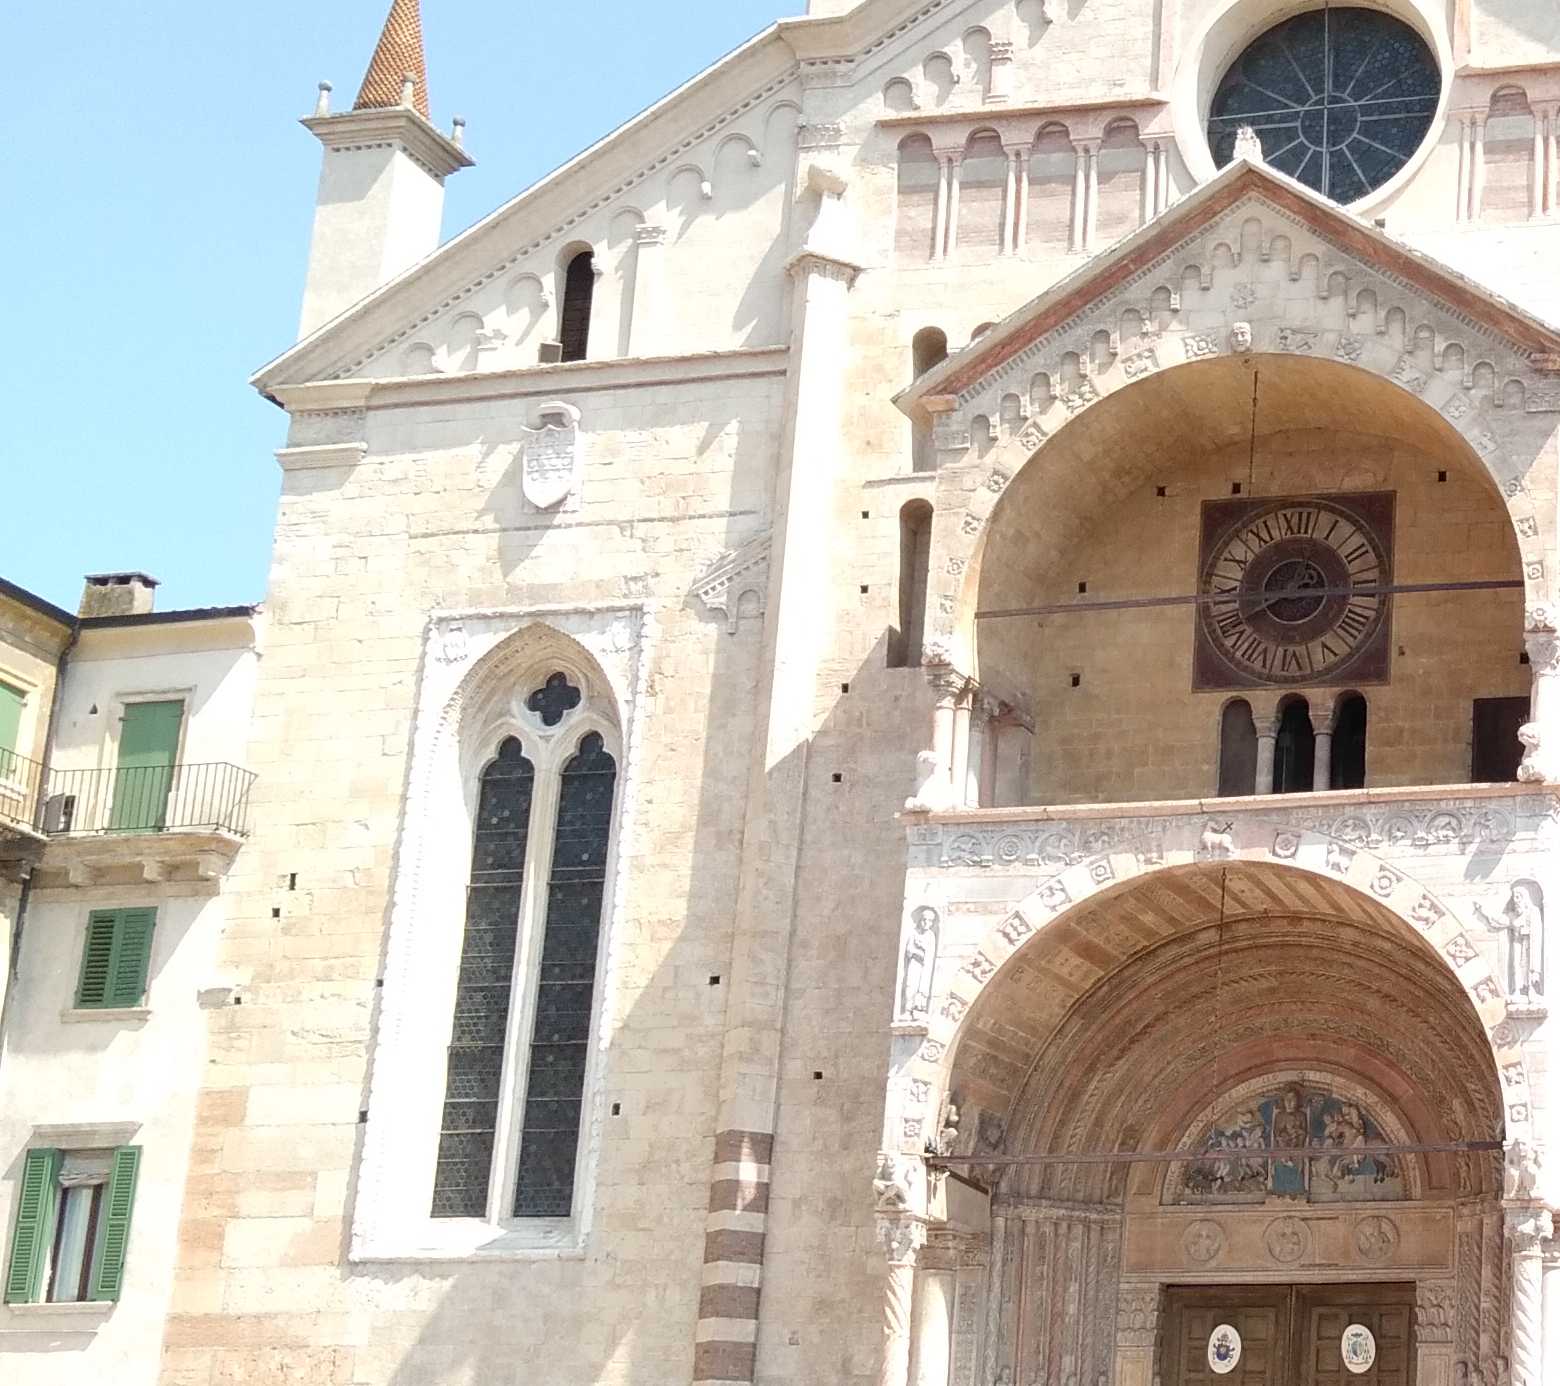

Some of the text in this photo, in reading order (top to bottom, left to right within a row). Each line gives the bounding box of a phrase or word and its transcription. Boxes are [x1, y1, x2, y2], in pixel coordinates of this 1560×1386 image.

[1248, 520, 1274, 548] XI
[1282, 511, 1312, 536] XII
[1324, 519, 1340, 542] I
[1223, 550, 1249, 571] X
[1344, 542, 1369, 565] II
[1280, 648, 1303, 672] VI
[1320, 640, 1340, 663] V
